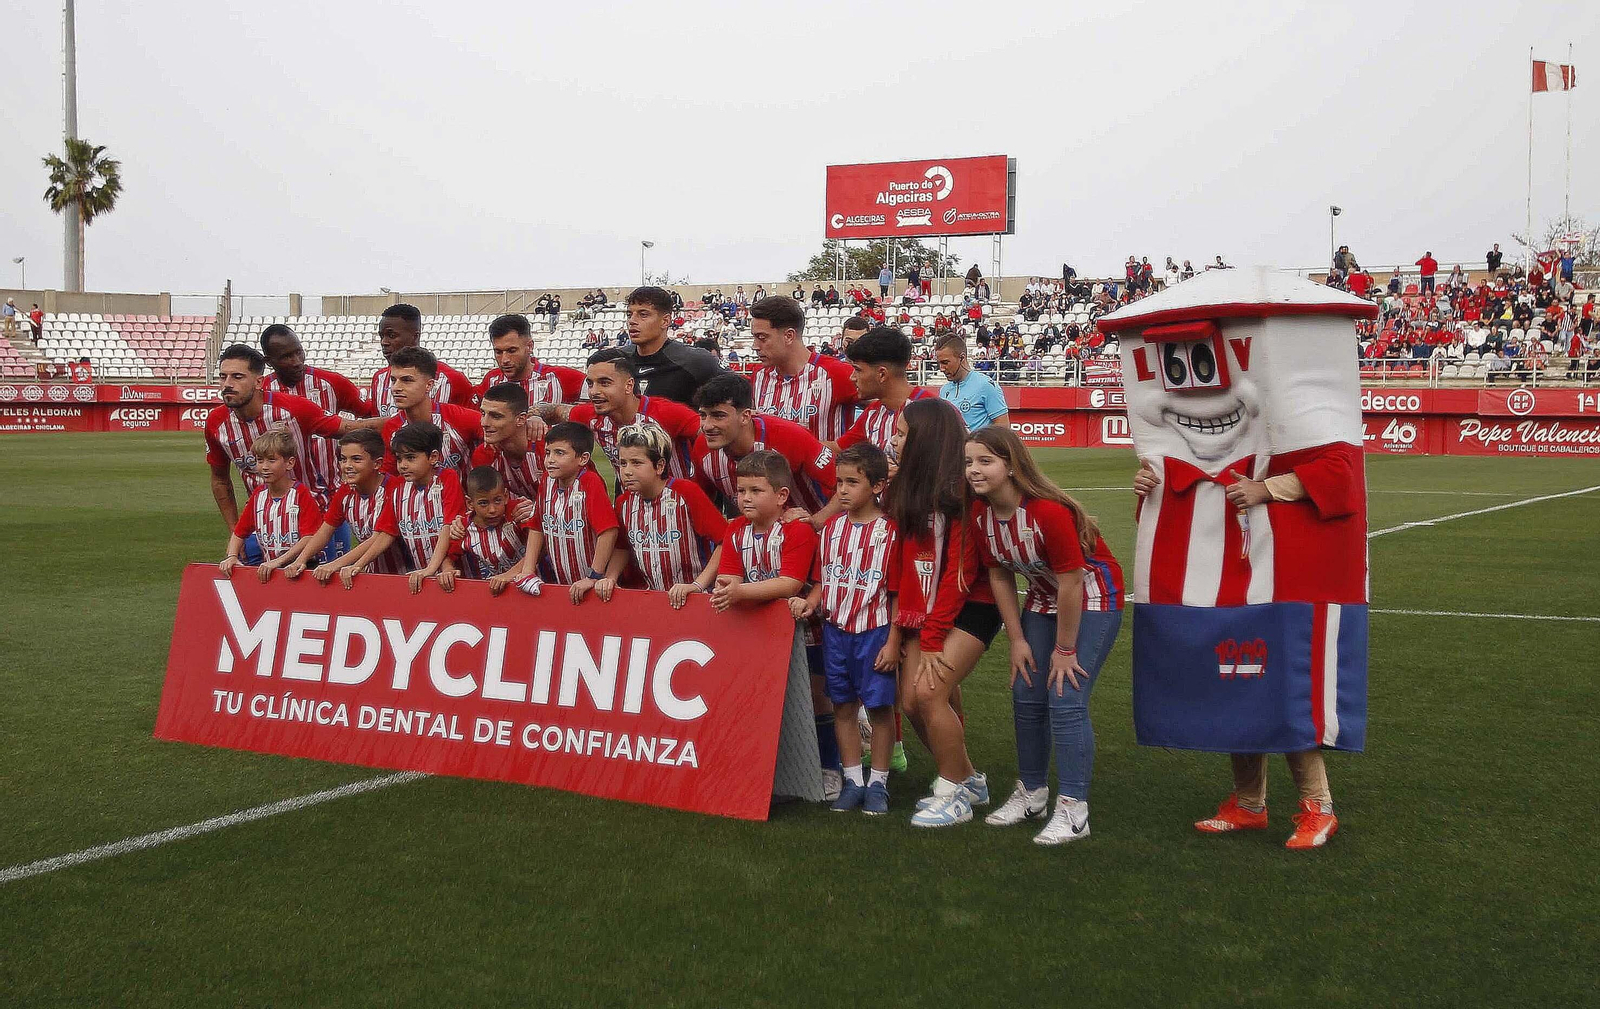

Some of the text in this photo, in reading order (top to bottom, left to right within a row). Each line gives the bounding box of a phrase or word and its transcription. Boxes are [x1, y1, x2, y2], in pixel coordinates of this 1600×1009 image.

[890, 179, 933, 191] Puerto de
[875, 190, 933, 206] Algeciras
[845, 214, 886, 223] ALGECIRAS
[32, 407, 82, 417] ALBORÁN
[120, 408, 162, 420] caser
[122, 420, 150, 429] seguros
[1459, 419, 1513, 447] Pepe
[1498, 444, 1537, 452] BOUTIQUE
[1550, 445, 1600, 454] CABALLEROS
[627, 529, 682, 545] SCAMP
[826, 564, 883, 583] SCAMP
[213, 579, 715, 721] MEDYCLINIC
[213, 690, 699, 768] TU CLÍNICA DENTAL DE CONFIANZA
